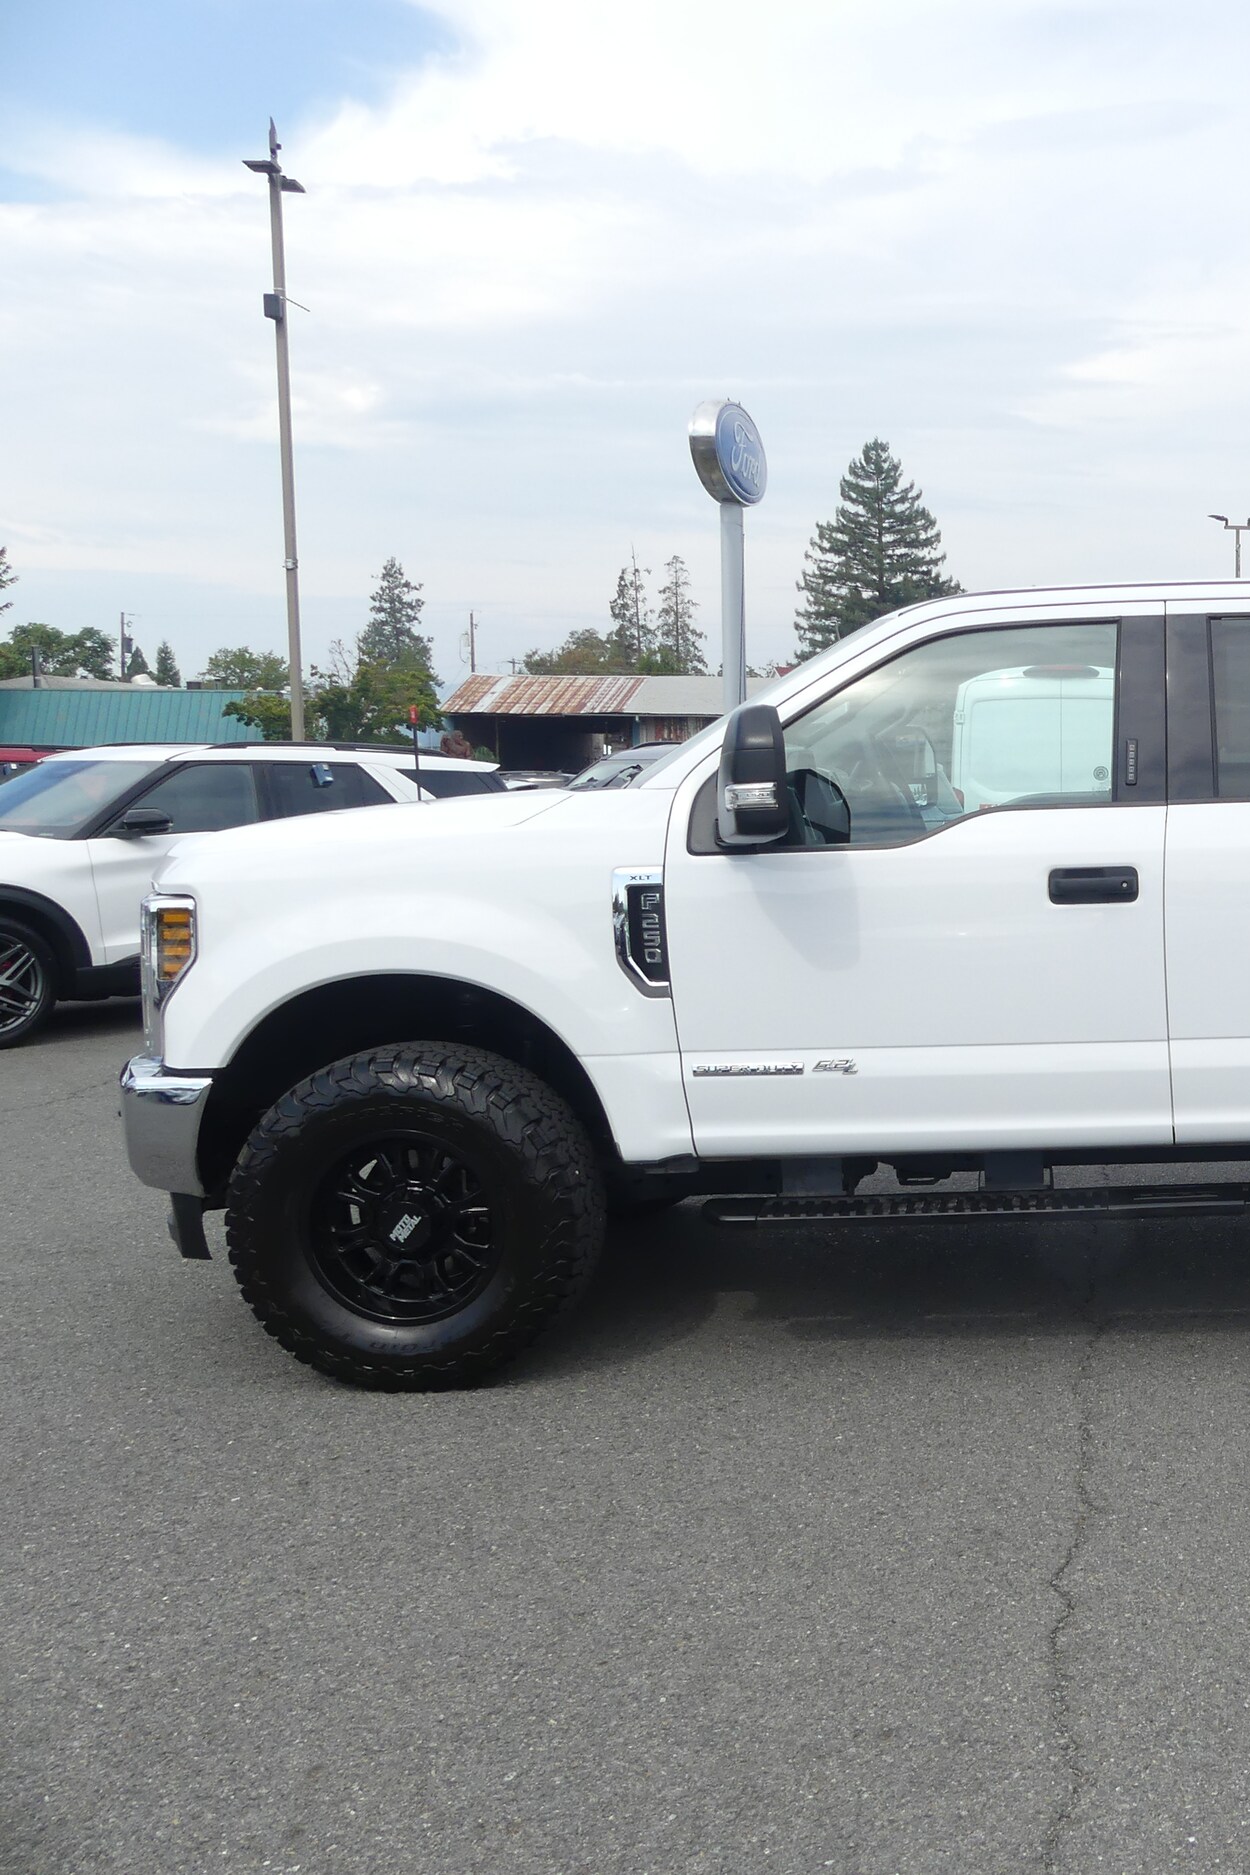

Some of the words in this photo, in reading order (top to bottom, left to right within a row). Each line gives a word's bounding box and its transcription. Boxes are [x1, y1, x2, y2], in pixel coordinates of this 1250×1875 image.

[731, 421, 761, 488] Ford
[696, 1064, 751, 1075] SUPER
[757, 1063, 799, 1075] DUTY
